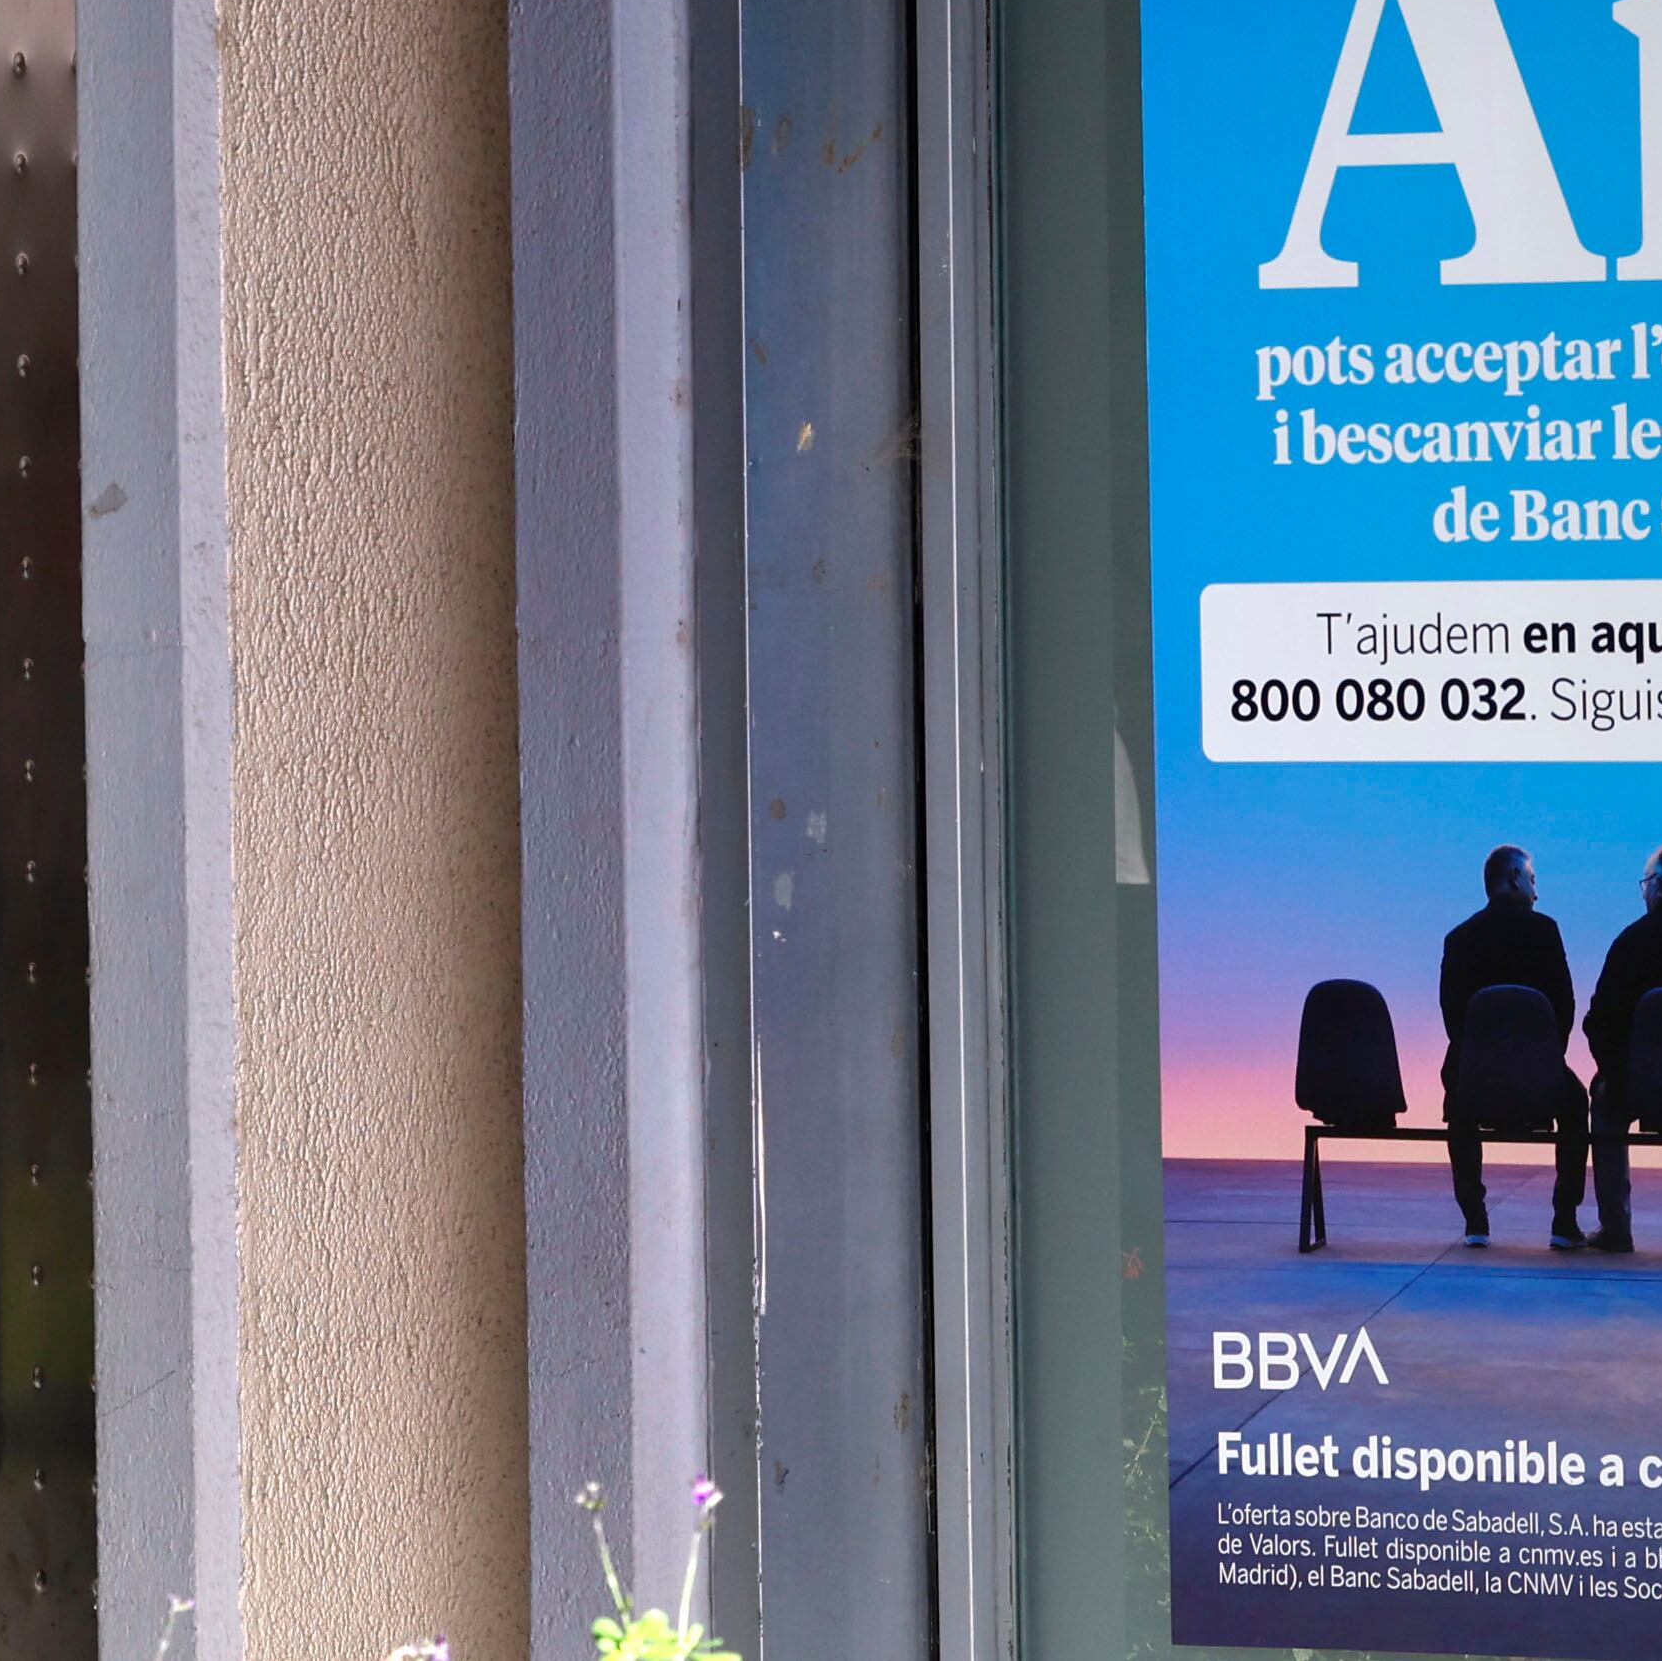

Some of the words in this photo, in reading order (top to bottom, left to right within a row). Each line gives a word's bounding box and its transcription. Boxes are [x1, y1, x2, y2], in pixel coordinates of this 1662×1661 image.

[1256, 337, 1374, 400] pots
[1385, 332, 1621, 396] acceptar
[1274, 411, 1292, 465] i
[1300, 409, 1602, 464] bescanviar
[1433, 486, 1499, 542] de
[1510, 490, 1650, 541] Banc
[1524, 622, 1575, 653] en
[1231, 679, 1320, 722] 800
[1336, 678, 1425, 721] 080
[1441, 678, 1536, 721] 032.
[1213, 1326, 1389, 1391] BBVA
[1218, 1432, 1339, 1477] Fullet
[1352, 1435, 1585, 1491] disponible
[1599, 1454, 1624, 1486] a
[1295, 1505, 1351, 1528] sobre
[1356, 1506, 1419, 1530] Banco
[1423, 1508, 1447, 1531] de
[1452, 1509, 1544, 1537] Sabadell,
[1549, 1512, 1589, 1536] S.A.
[1593, 1514, 1617, 1537] ha
[1218, 1533, 1242, 1554] de
[1249, 1533, 1316, 1556] Valors.
[1325, 1535, 1378, 1558] Fullet
[1386, 1537, 1491, 1565] disponible
[1499, 1547, 1510, 1563] a
[1519, 1548, 1603, 1567] cnmv.es
[1625, 1552, 1636, 1568] a
[1219, 1562, 1302, 1590] Madrid),
[1308, 1565, 1324, 1586] el
[1331, 1565, 1381, 1588] Banc
[1387, 1567, 1479, 1594] Sabadell,
[1485, 1571, 1501, 1593] la
[1508, 1571, 1573, 1596] CNMV
[1590, 1575, 1618, 1598] les
